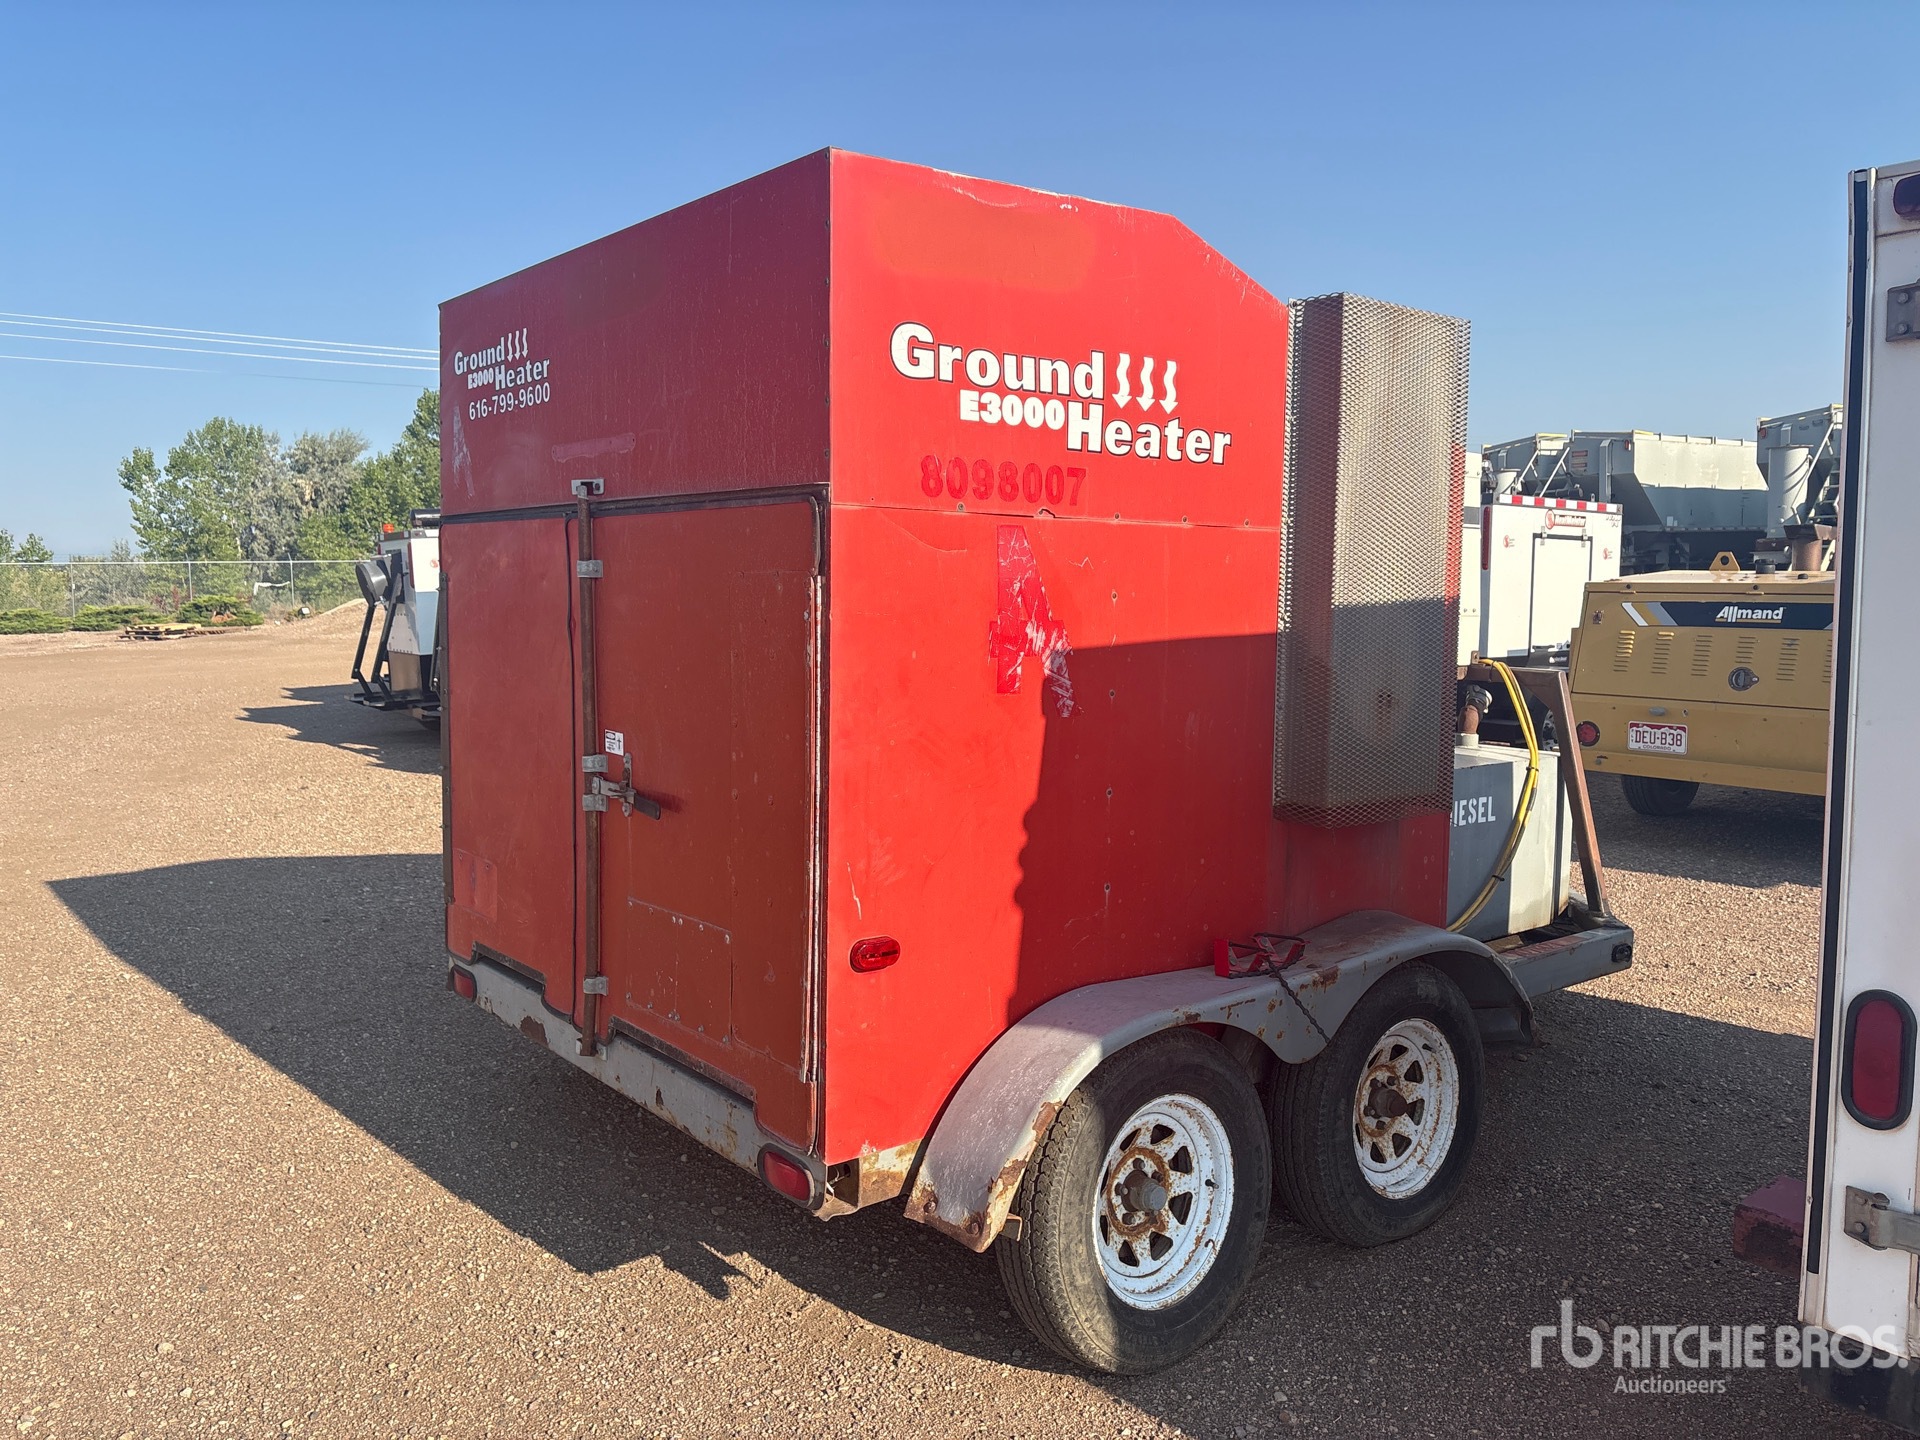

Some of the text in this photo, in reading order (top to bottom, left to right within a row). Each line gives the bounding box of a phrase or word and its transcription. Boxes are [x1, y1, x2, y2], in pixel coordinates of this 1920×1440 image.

[454, 336, 505, 375] Ground
[494, 359, 550, 391] Heater
[890, 321, 1105, 400] Ground
[467, 370, 494, 390] E3000
[469, 382, 550, 421] 616-799-9600
[959, 389, 1066, 431] E3000
[1066, 400, 1232, 465] Heater
[920, 454, 1088, 506] 8098007
[1716, 606, 1784, 622] Allmand
[1450, 796, 1496, 827] IESEL
